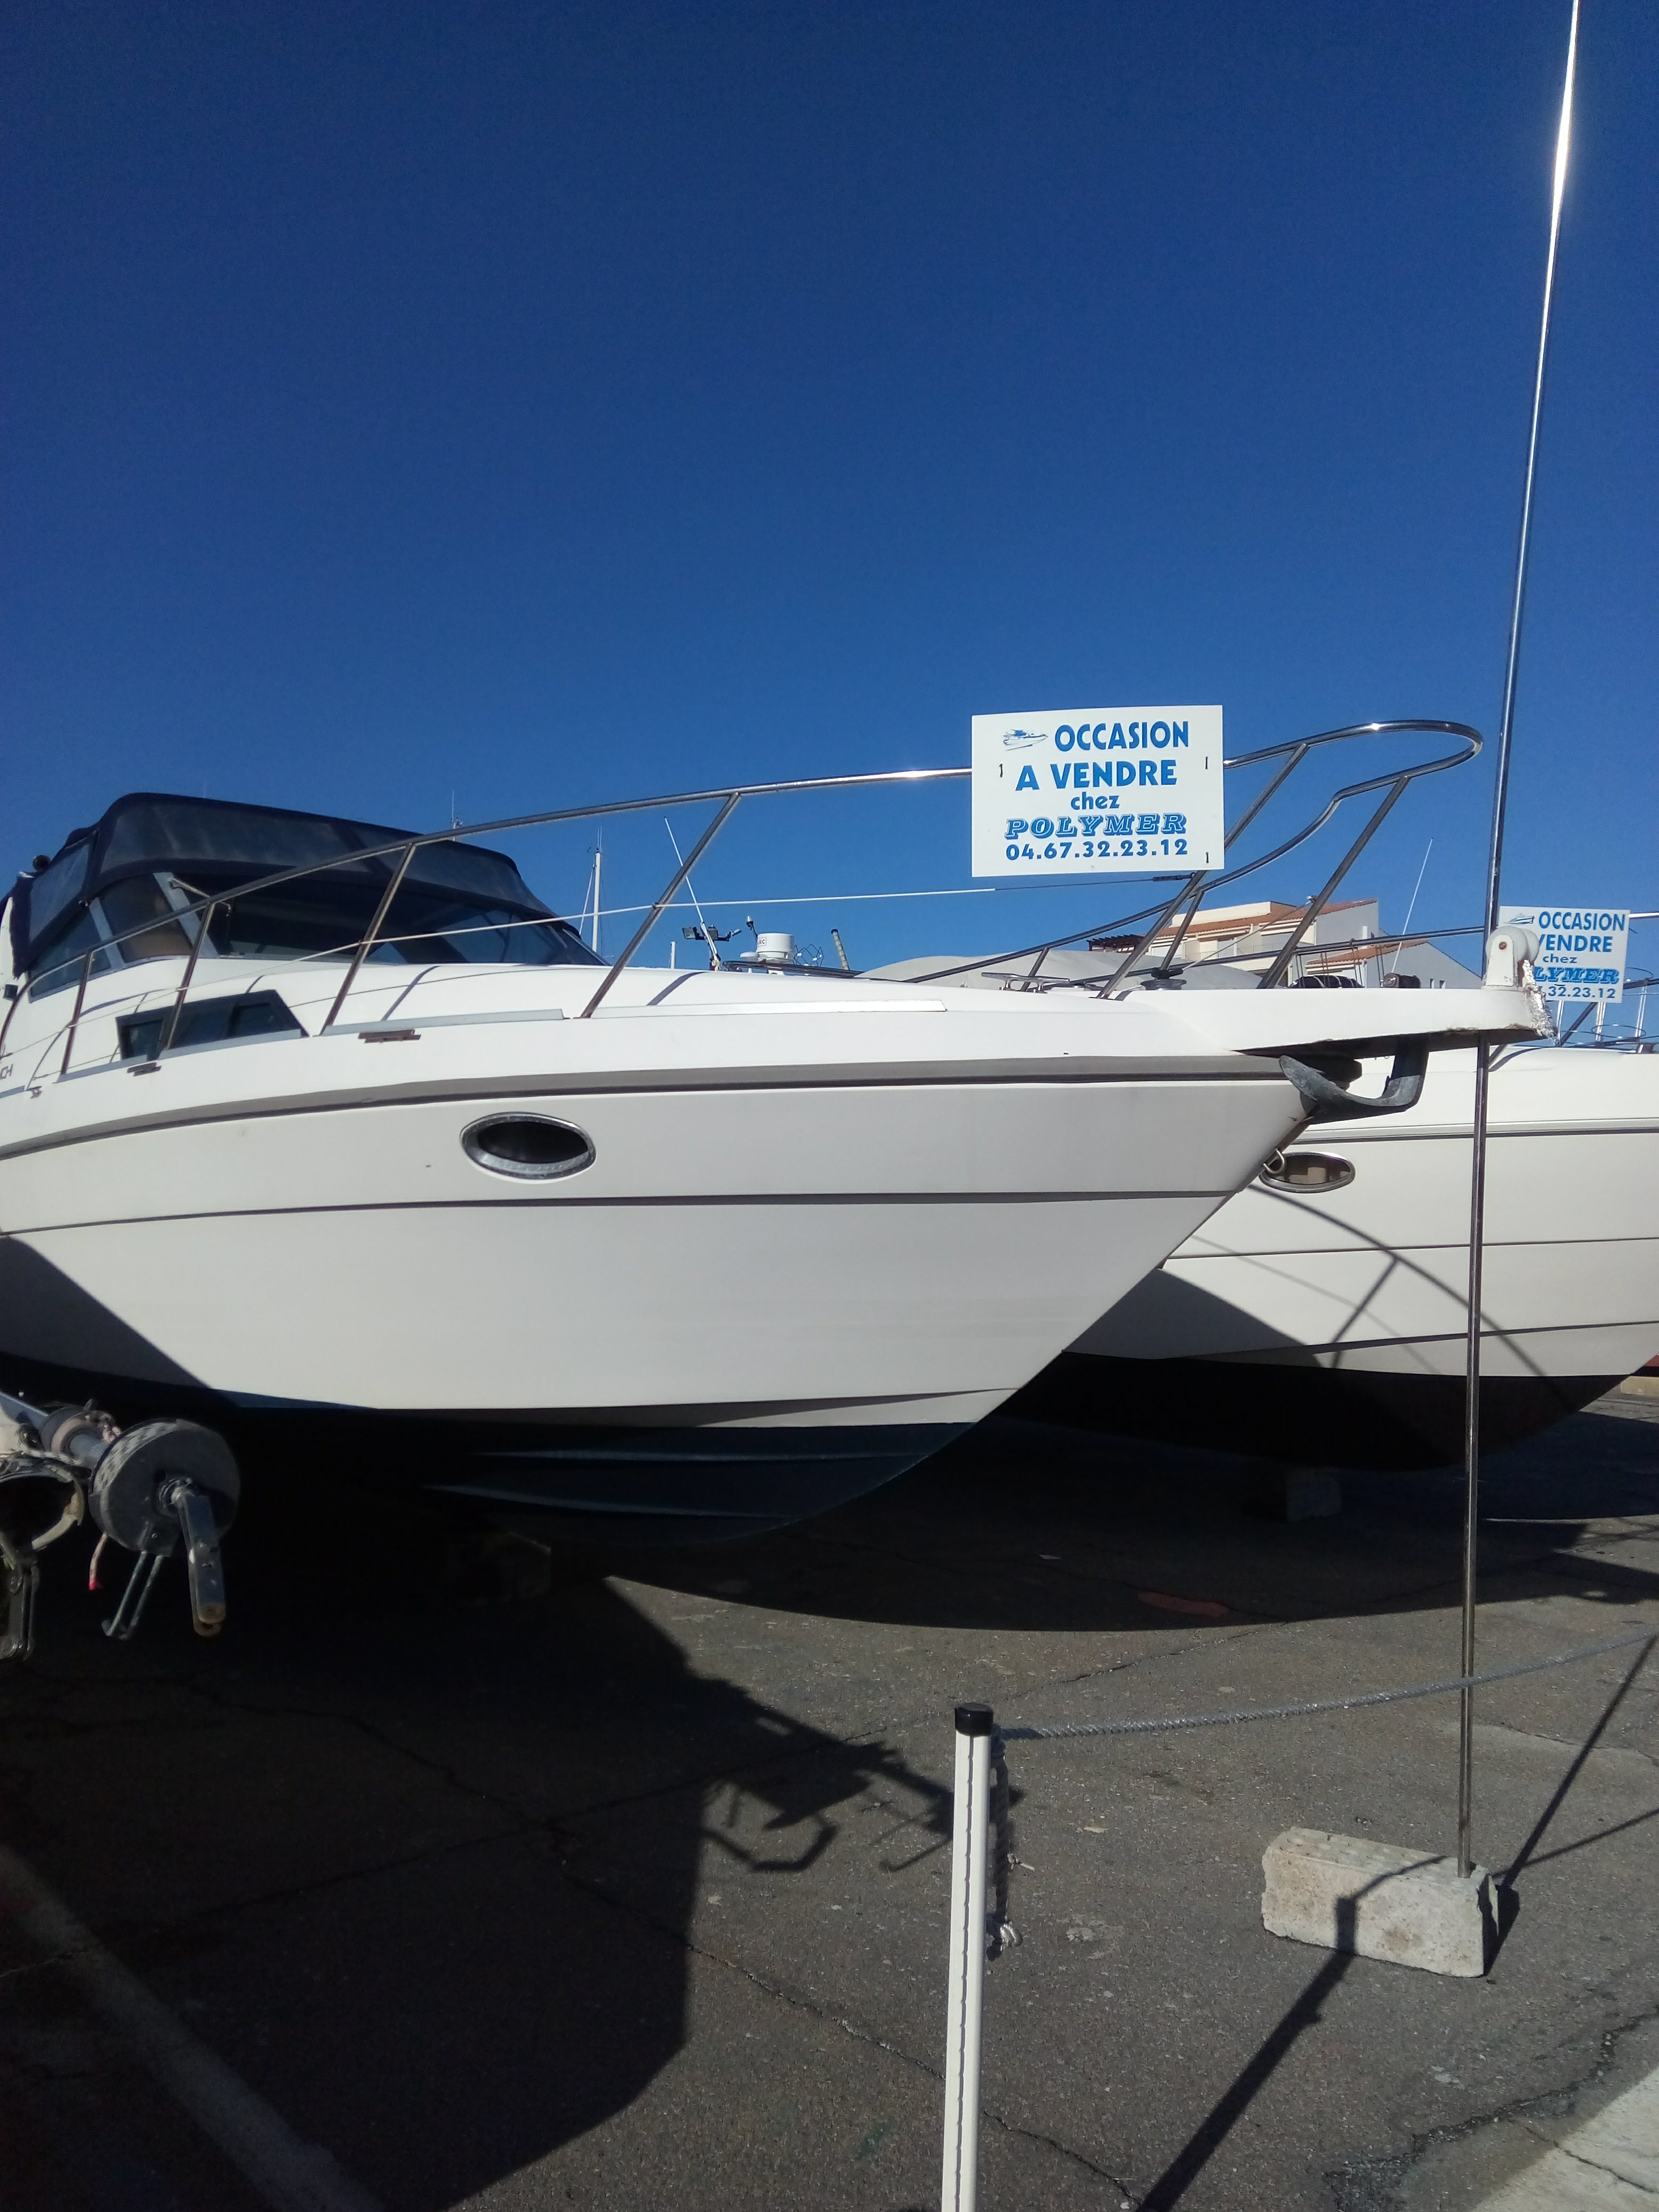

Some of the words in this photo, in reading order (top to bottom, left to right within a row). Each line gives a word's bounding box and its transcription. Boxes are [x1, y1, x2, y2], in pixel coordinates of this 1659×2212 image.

[1054, 721, 1189, 752] OCCASION
[1015, 765, 1040, 791] A
[1050, 759, 1177, 789] VENDRE
[1070, 791, 1120, 810] chez
[1004, 812, 1187, 840] POLYMER
[1006, 839, 1188, 860] 04.67.32.23.12
[1539, 911, 1626, 931] OCCASION
[1542, 953, 1578, 963] chez
[1534, 966, 1620, 984] LYMER
[1547, 986, 1616, 999] 32.23.12
